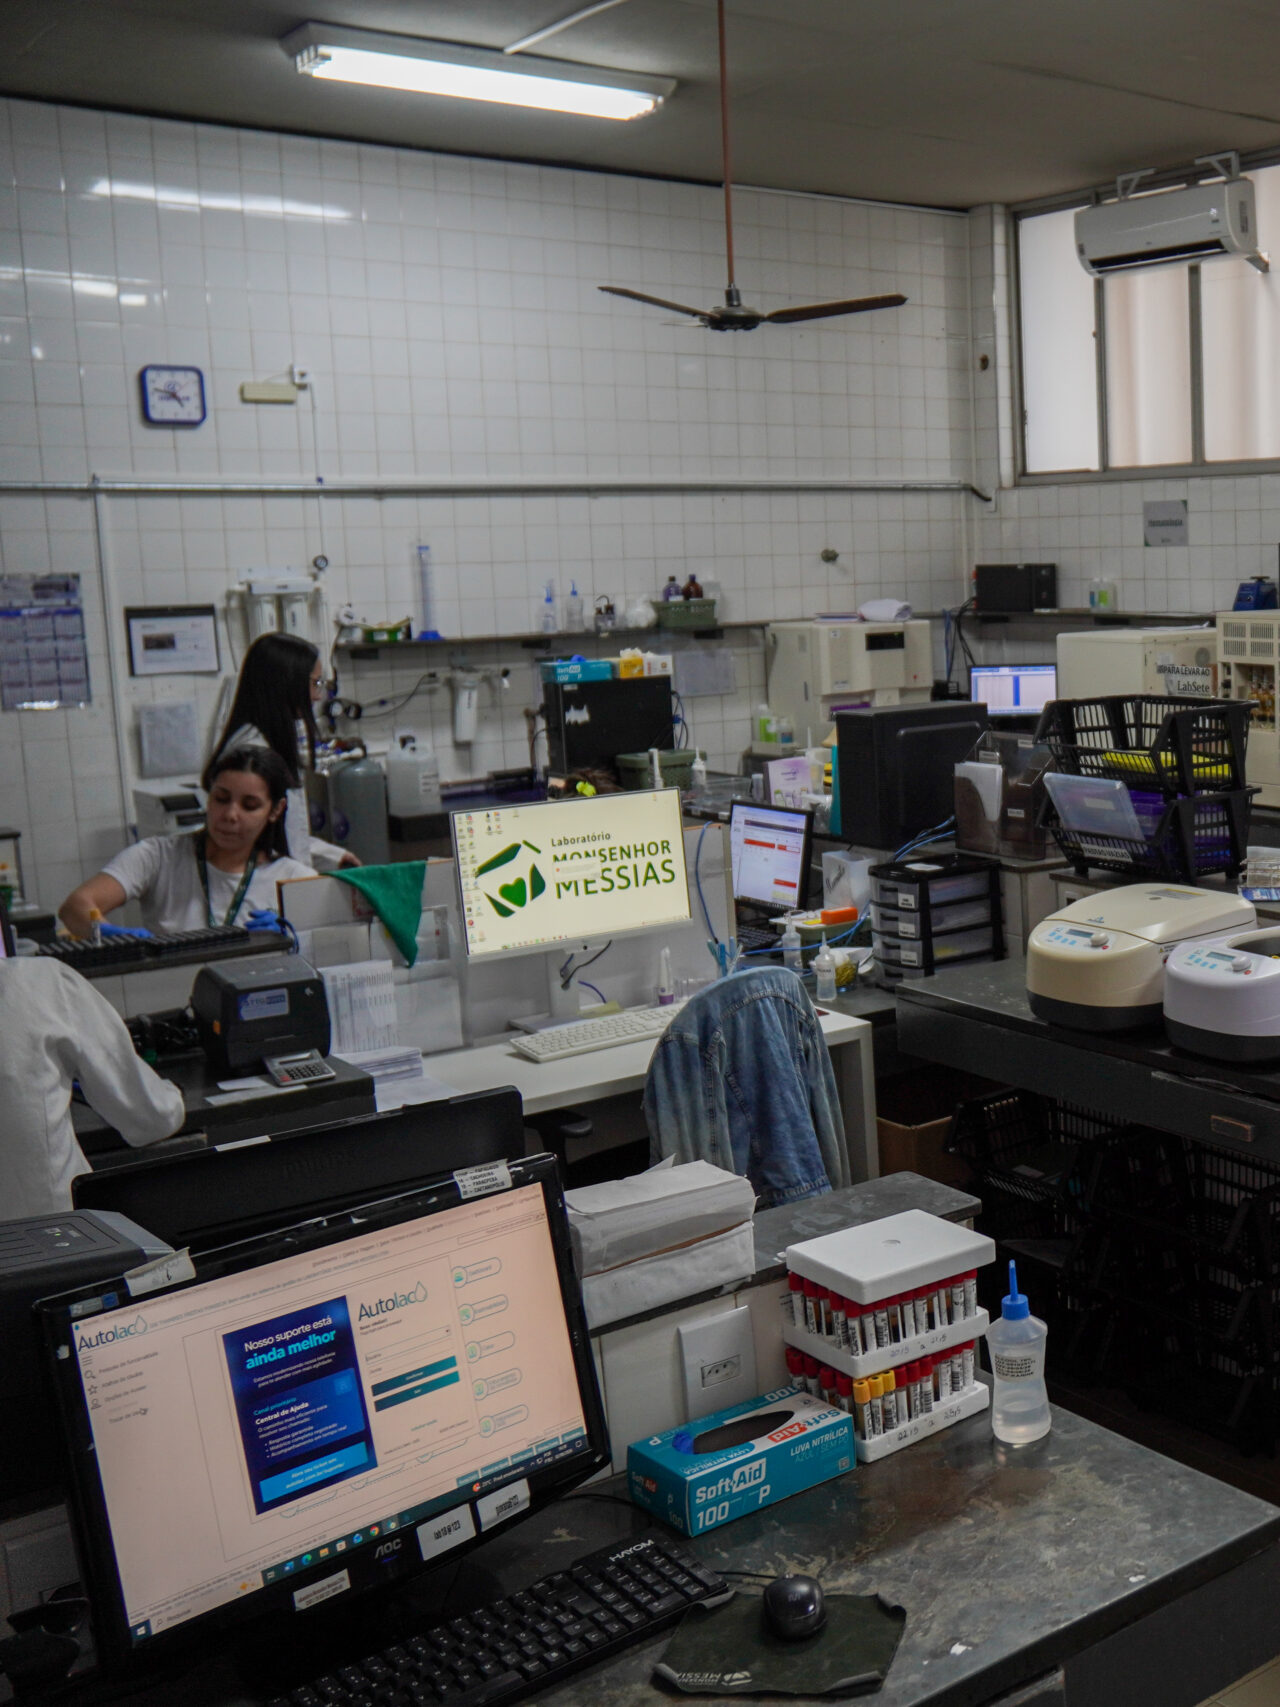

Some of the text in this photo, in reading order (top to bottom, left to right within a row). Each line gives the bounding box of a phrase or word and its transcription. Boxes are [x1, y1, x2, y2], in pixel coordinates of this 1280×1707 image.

[1163, 665, 1180, 674] PARA
[1181, 666, 1200, 676] LEVAR
[1201, 668, 1210, 677] AO
[1177, 680, 1210, 693] LabSete
[551, 830, 611, 847] Laboratório
[555, 859, 676, 900] MESSIAS
[358, 1290, 416, 1321] Autolac
[77, 1322, 136, 1353] Autolac
[244, 1316, 332, 1352] Nosso suporte está
[245, 1329, 337, 1369] ainda melhor
[255, 1402, 309, 1426] Central de Ajuda
[648, 1436, 662, 1446] P
[790, 1426, 849, 1457] LUVA NITRÍLICA
[758, 1484, 771, 1505] P
[696, 1501, 730, 1529] 100
[374, 1537, 402, 1559] AOC
[609, 1538, 655, 1563] HAYOM
